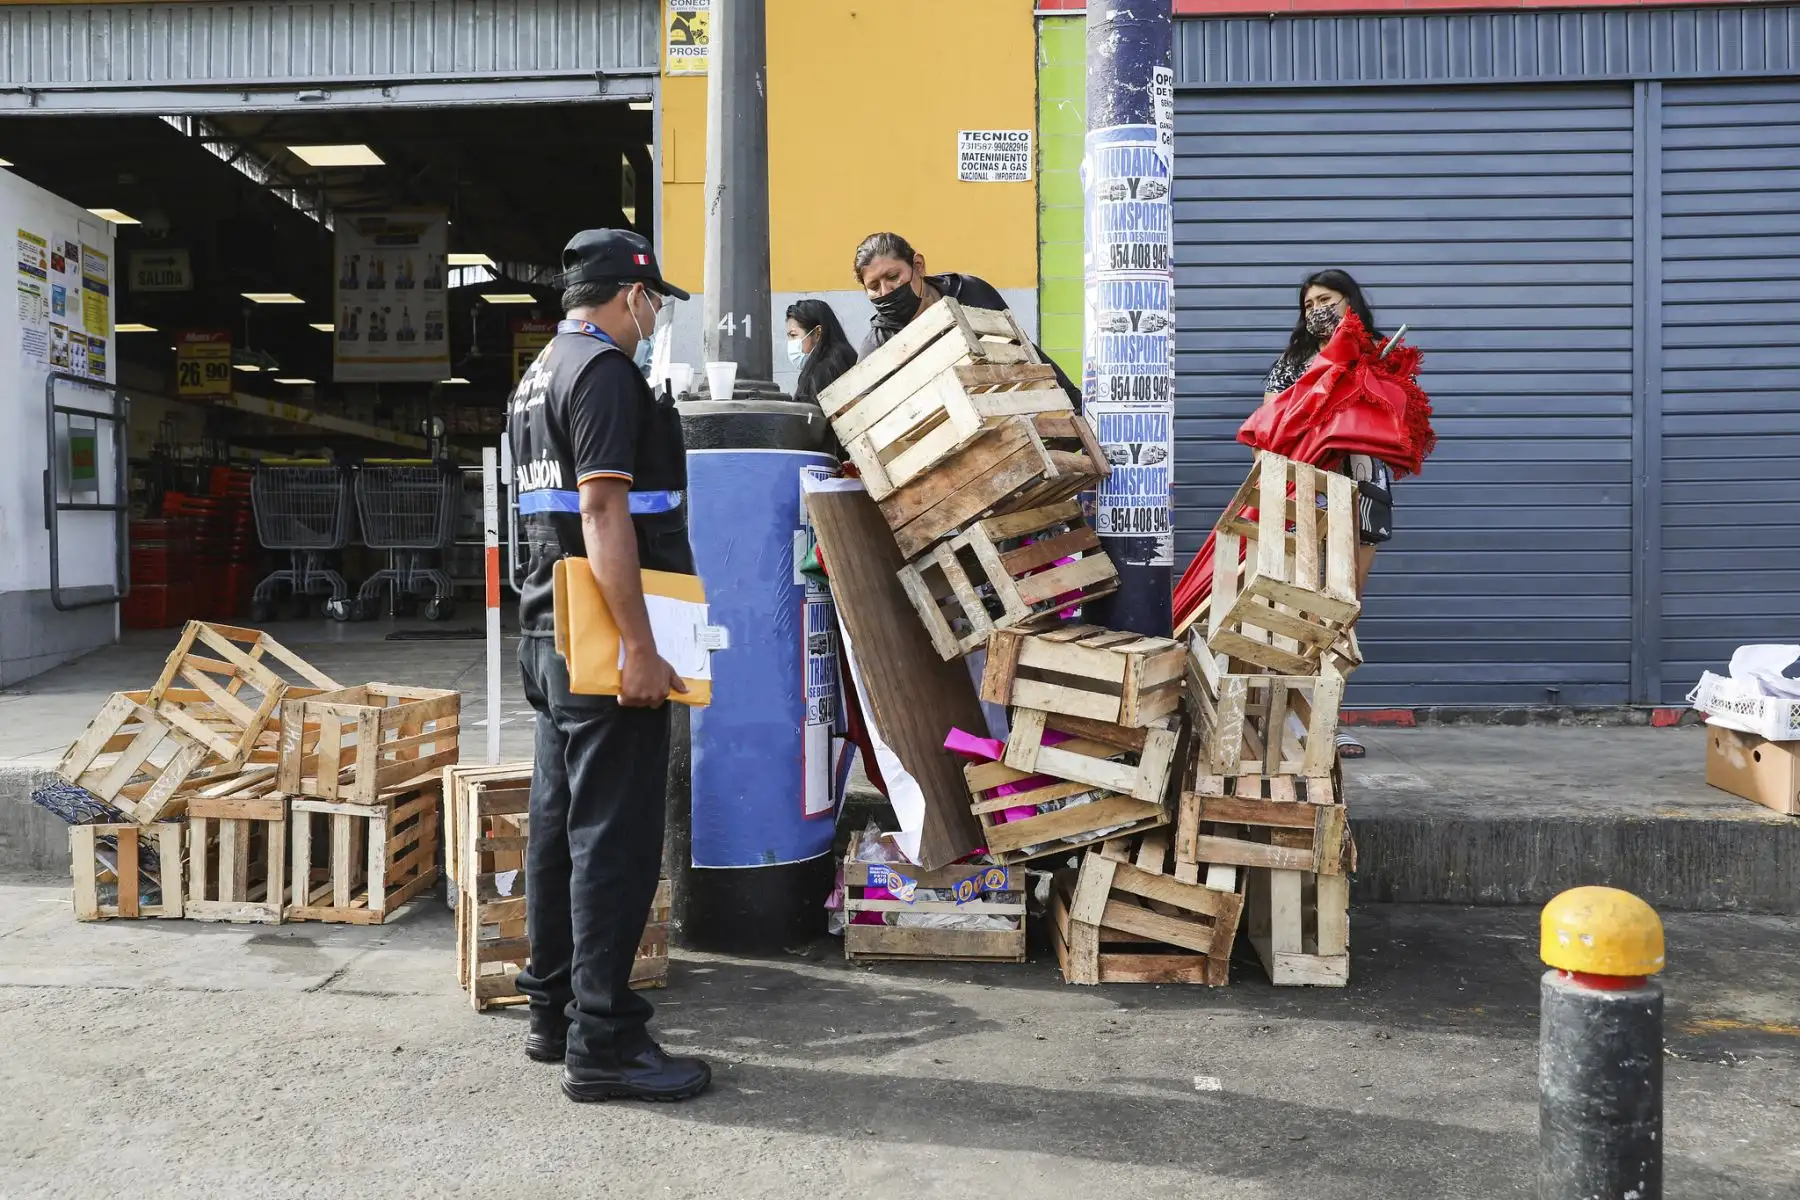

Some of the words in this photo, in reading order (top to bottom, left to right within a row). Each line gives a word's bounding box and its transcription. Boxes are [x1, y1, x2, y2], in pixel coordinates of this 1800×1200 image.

[1156, 87, 1167, 96] DE
[962, 132, 1029, 141] TECNICO
[961, 152, 1028, 162] MATENIMIENTO
[961, 162, 999, 171] COCINAS
[1010, 163, 1027, 171] GAS
[961, 172, 988, 180] NACIONAL
[995, 172, 1027, 180] IMPORTADA
[1127, 177, 1140, 199] Y
[1107, 232, 1128, 243] BOTA
[1129, 232, 1167, 243] DESMONTE
[1110, 243, 1129, 269] 954
[1131, 243, 1151, 268] 408
[138, 270, 183, 286] SALIDA
[1100, 281, 1167, 310] MUDANZA
[1128, 310, 1143, 332] Y
[1100, 335, 1167, 363] TRANSPORTE
[1098, 364, 1107, 375] SE
[1108, 364, 1129, 375] BOTA
[1130, 364, 1167, 375] DESMONTE
[1111, 376, 1130, 401] 954
[1132, 376, 1151, 401] 408
[1153, 376, 1168, 401] 943
[1100, 414, 1167, 443] MUDANZA
[1129, 443, 1142, 465] Y
[1099, 496, 1107, 507] SE
[1109, 496, 1129, 507] BOTA
[1131, 496, 1167, 506] DESMONTE
[1111, 507, 1131, 533] 954
[1133, 507, 1152, 532] 408
